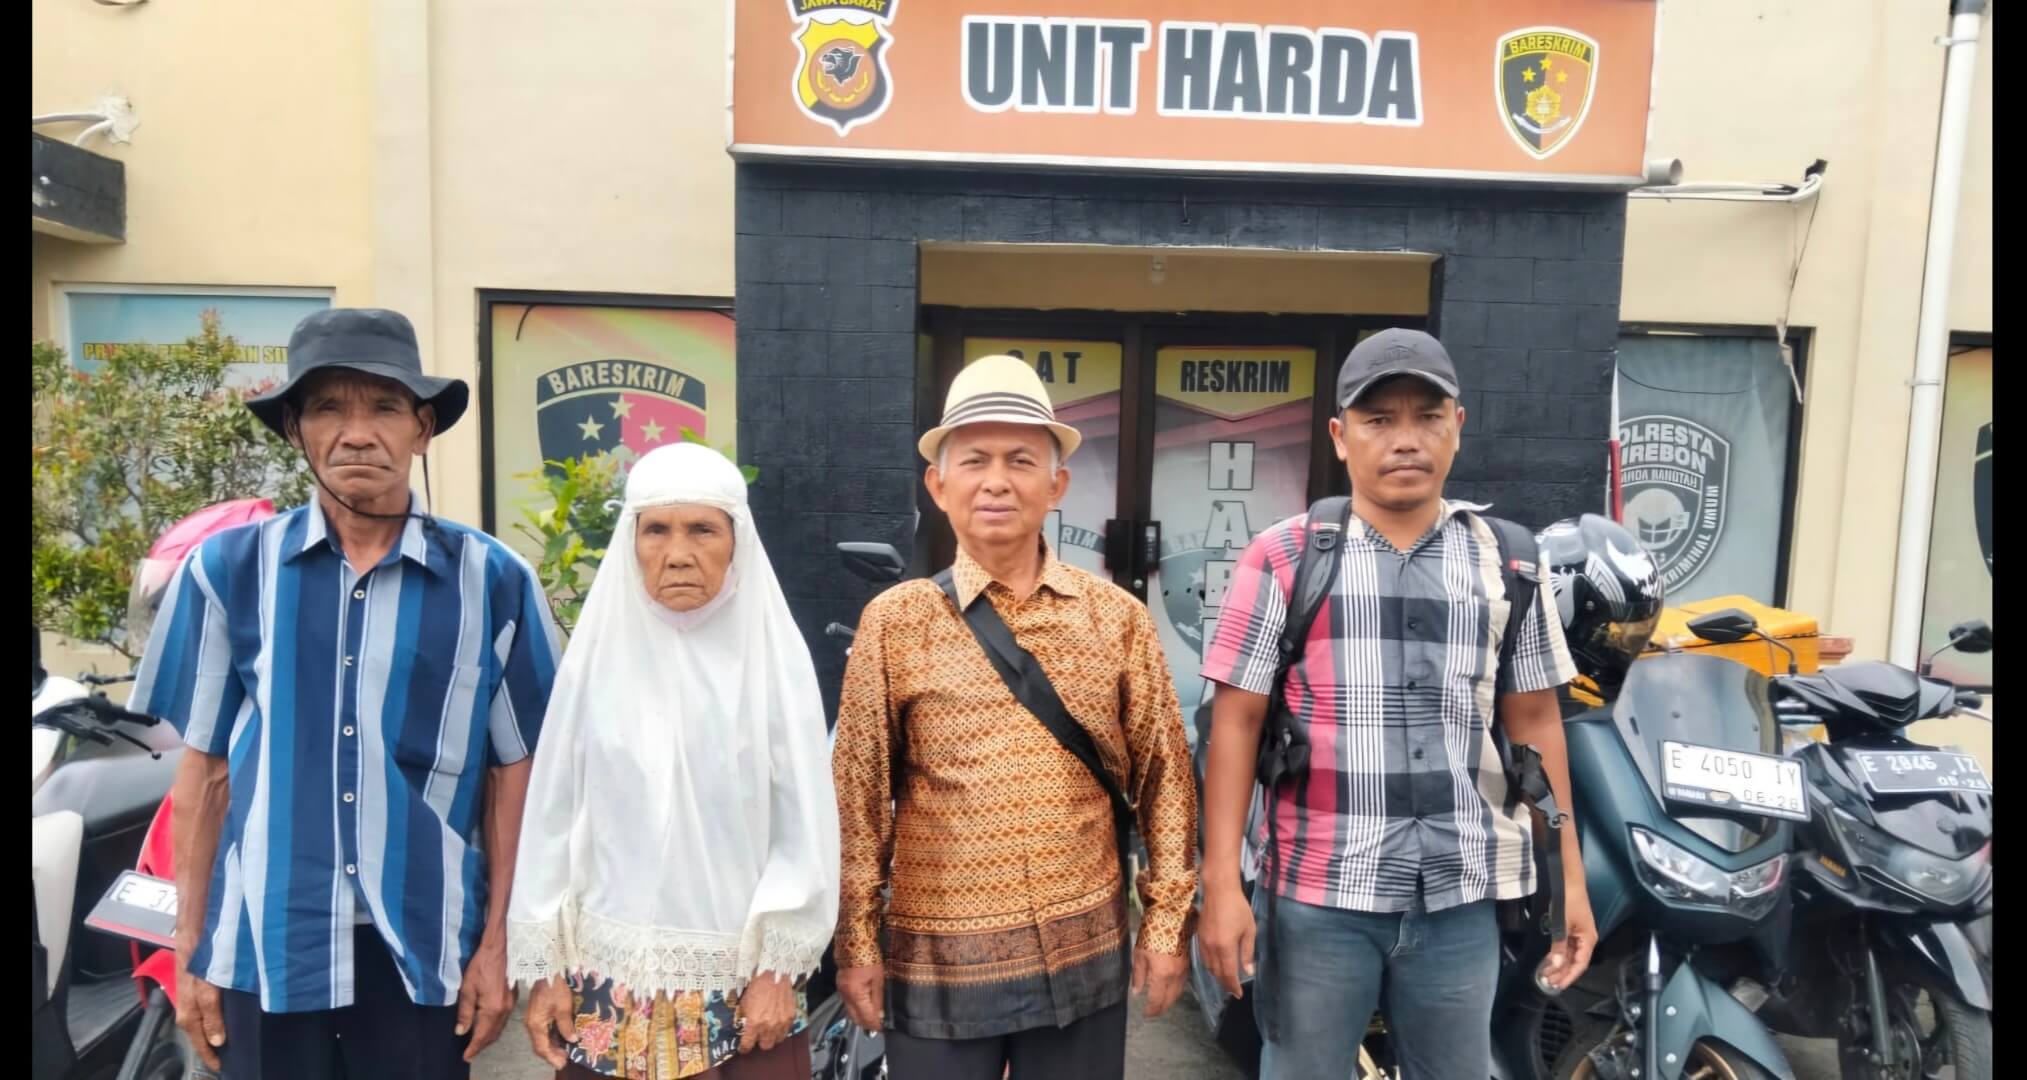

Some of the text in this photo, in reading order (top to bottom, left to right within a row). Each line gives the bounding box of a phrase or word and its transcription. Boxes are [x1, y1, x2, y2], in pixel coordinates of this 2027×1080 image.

[1508, 35, 1588, 59] BARESKRIM
[966, 20, 1419, 121] UNIT HARDA
[547, 362, 687, 398] BARESKRIM
[1007, 349, 1082, 384] AT
[1180, 359, 1291, 393] RESKRIM
[1619, 423, 1717, 461] OLRESTA
[1620, 443, 1706, 475] IREBON
[1672, 749, 1682, 769] E
[1701, 753, 1752, 779] 4050
[1861, 755, 1878, 772] E
[117, 881, 137, 902] E
